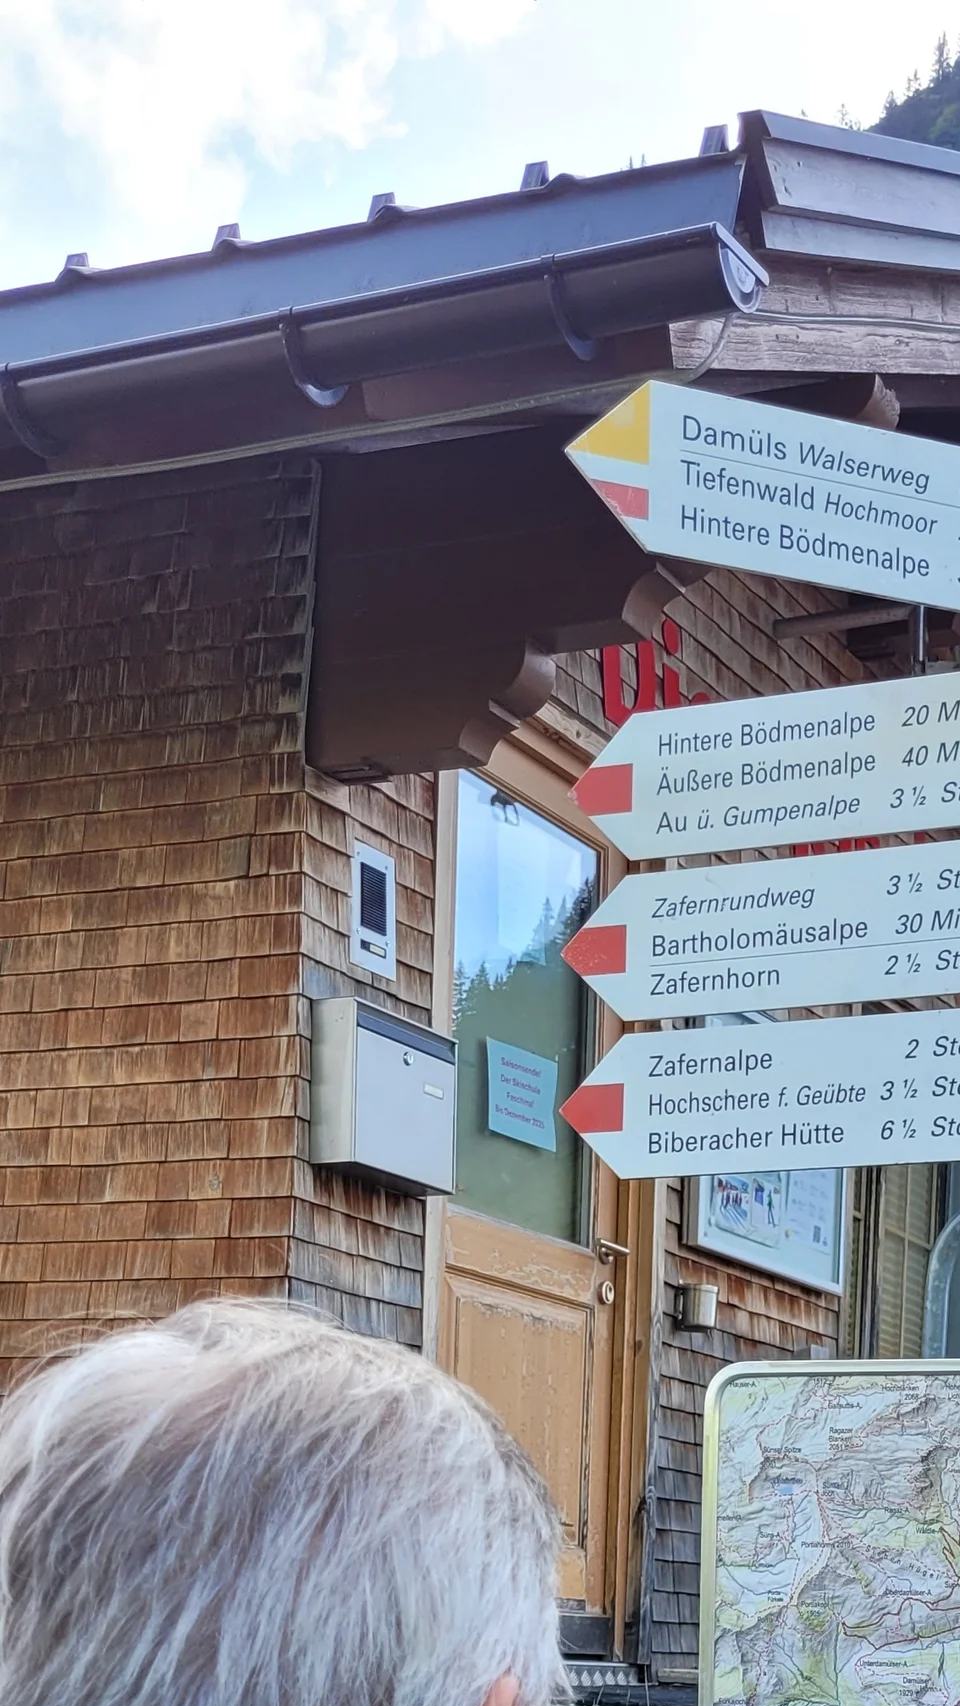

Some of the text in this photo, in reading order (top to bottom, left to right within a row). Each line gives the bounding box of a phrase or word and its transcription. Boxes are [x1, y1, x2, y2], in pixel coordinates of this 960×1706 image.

[682, 415, 787, 460] Damüls
[798, 442, 931, 496] Walserweg
[680, 460, 815, 511] Tiefenwald
[824, 492, 939, 535] Hochmoor
[681, 504, 770, 546] Hintere
[779, 523, 930, 579] Bödmenalpe
[658, 732, 733, 757] Hintere
[740, 711, 876, 747] Bödmenalpe
[901, 704, 930, 728] 20
[656, 766, 733, 796] Äußere
[741, 751, 876, 786] Bödmenalpe
[901, 745, 929, 767] 40
[655, 811, 687, 835] Au
[697, 808, 714, 830] ü.
[723, 794, 861, 827] Gumpenalpe
[651, 887, 816, 919] Zafernrundweg
[652, 919, 868, 957] Bartholomäusalpe
[895, 912, 923, 935] 30
[649, 963, 780, 996] Zafernhorn
[648, 1048, 773, 1078] Zafernalpe
[649, 1088, 770, 1116] Hochschere
[778, 1086, 788, 1108] f.
[796, 1083, 866, 1106] Geübte
[648, 1126, 773, 1154] Biberacher
[781, 1122, 844, 1147] Hütte
